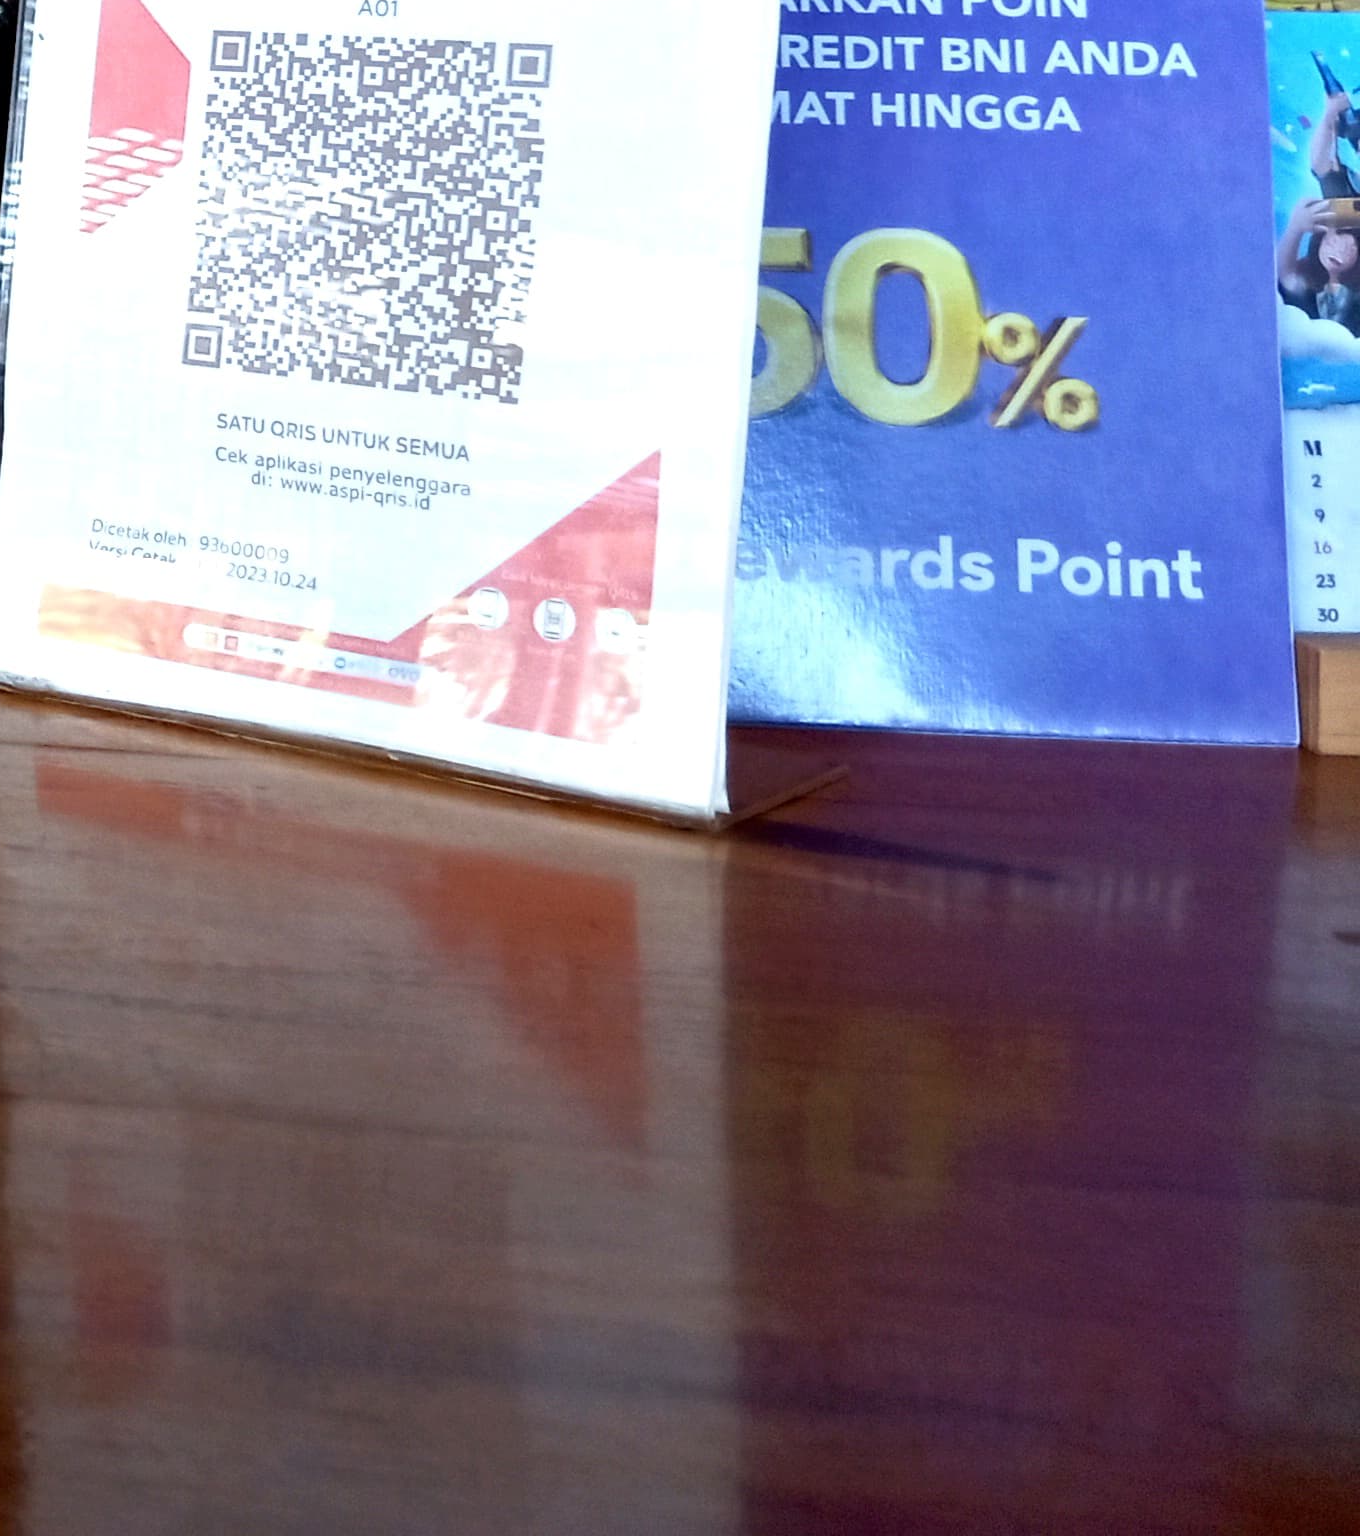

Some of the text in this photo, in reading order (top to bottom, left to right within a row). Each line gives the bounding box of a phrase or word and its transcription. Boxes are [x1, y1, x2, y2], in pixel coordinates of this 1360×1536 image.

[358, 0, 398, 16] A01
[778, 34, 1197, 78] REDIT BNI ANDA
[871, 92, 1081, 132] HINGGA
[217, 413, 470, 462] SATU QRIS UNTUK SEMUA
[1303, 440, 1323, 456] M
[215, 446, 471, 496] Cek aplikasi penyelenggara
[1311, 474, 1323, 488] 2
[251, 471, 431, 511] di: www.aspi-qris.id
[1314, 509, 1325, 523] 9
[92, 518, 149, 541] Dicetak
[154, 532, 186, 548] oleh
[1314, 540, 1333, 555] 16
[1017, 537, 1205, 600] Point
[1316, 573, 1336, 589] 23
[1317, 608, 1339, 623] 30
